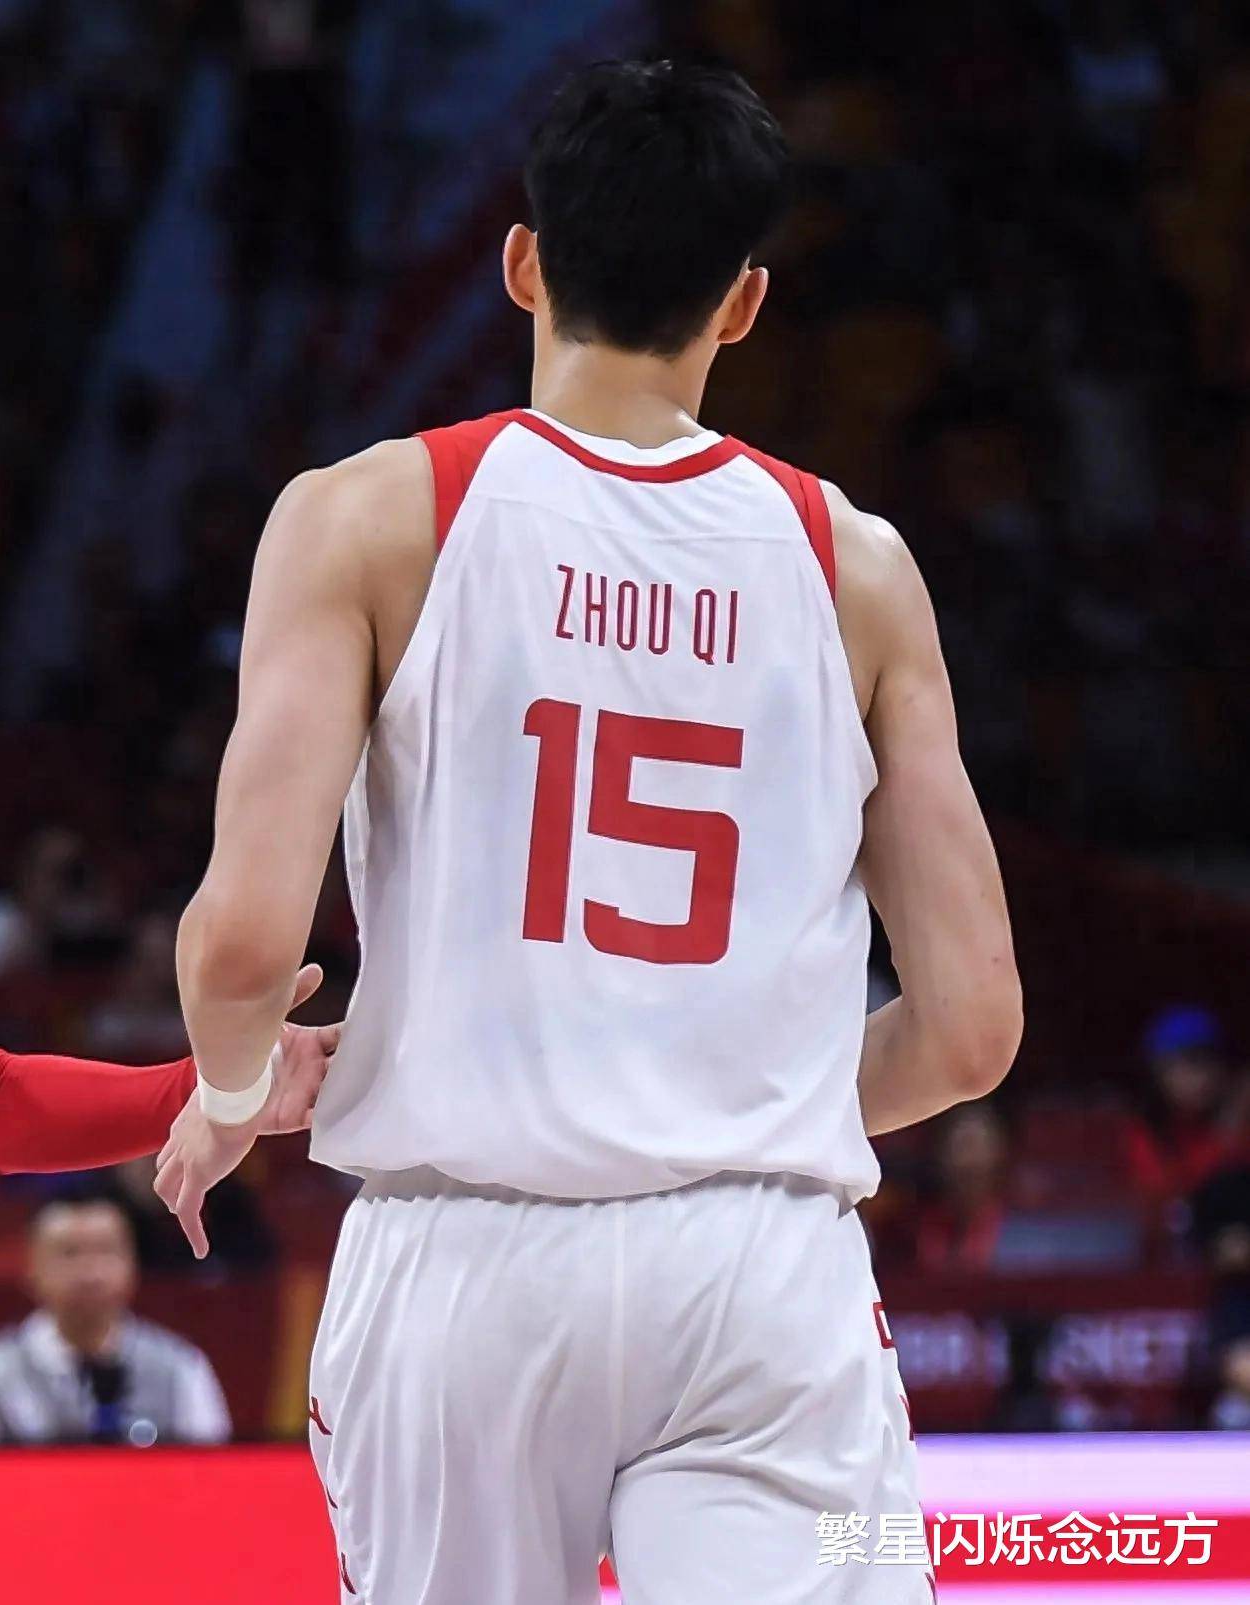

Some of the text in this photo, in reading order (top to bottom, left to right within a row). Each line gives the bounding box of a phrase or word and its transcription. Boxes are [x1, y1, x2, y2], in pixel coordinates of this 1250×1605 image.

[556, 564, 739, 665] ZHOU QI
[522, 698, 744, 966] 15
